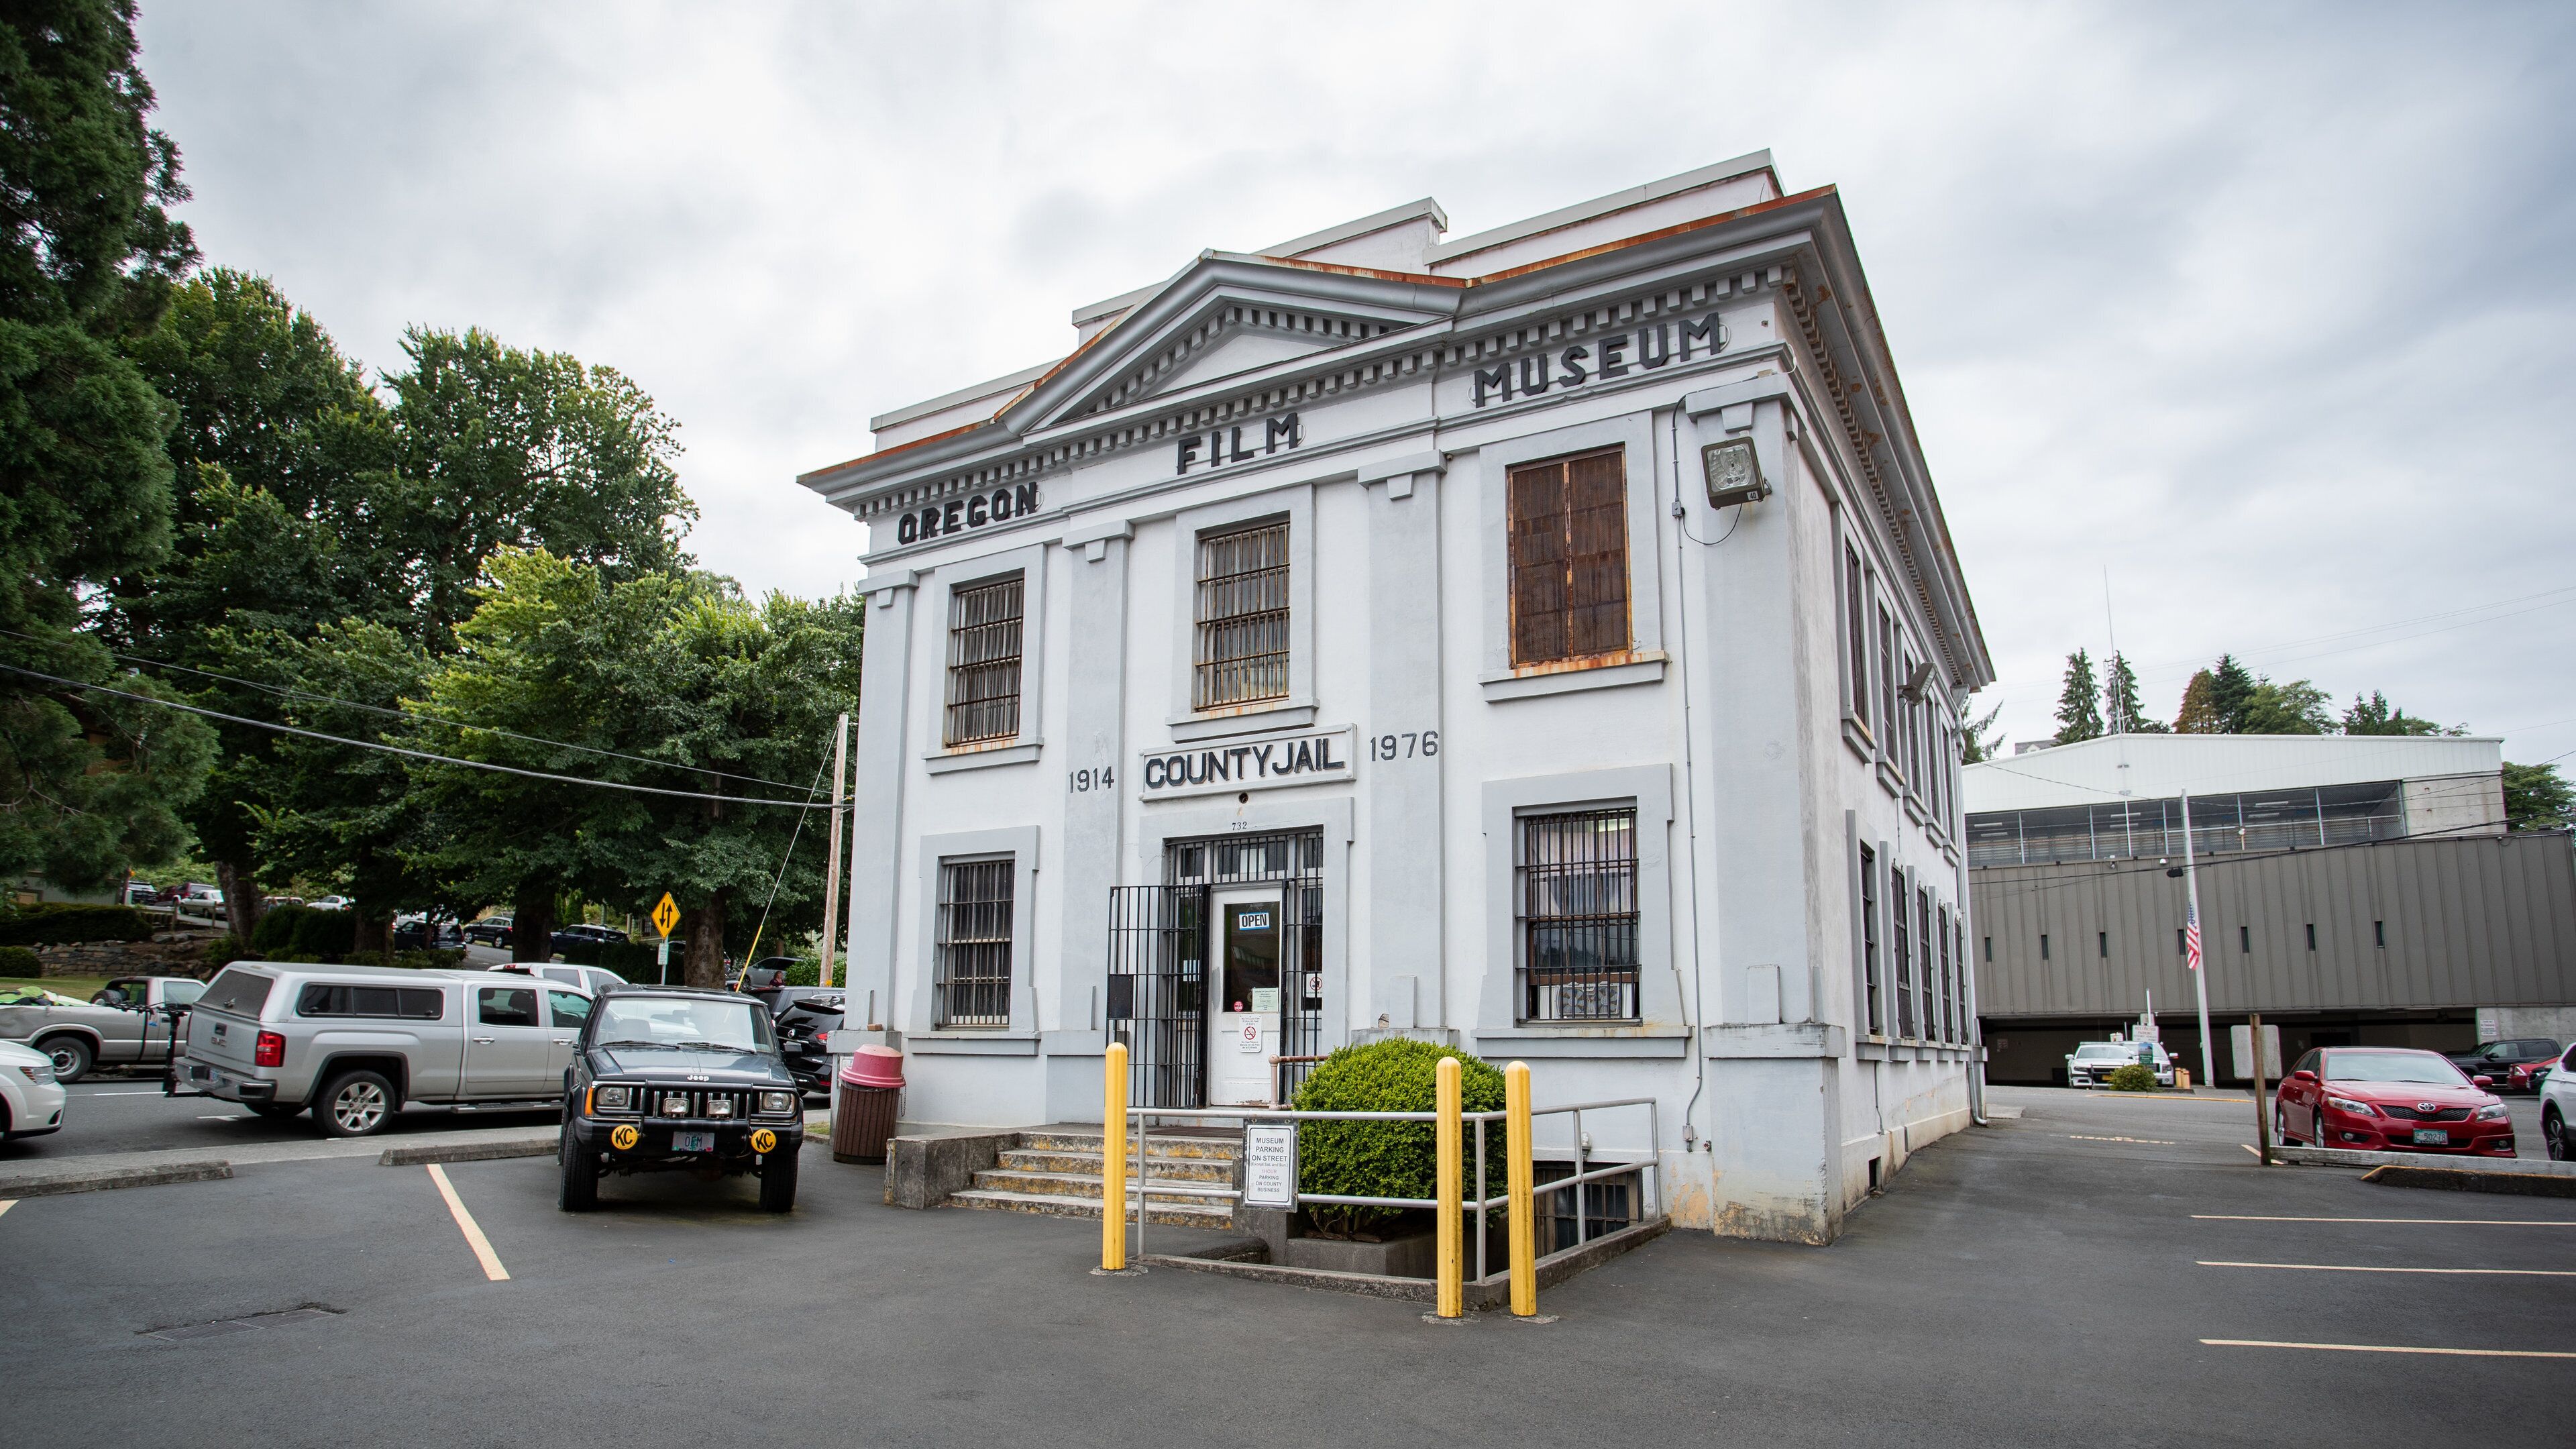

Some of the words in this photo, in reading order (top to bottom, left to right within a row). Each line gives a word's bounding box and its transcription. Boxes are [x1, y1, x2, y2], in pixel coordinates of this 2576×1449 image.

[1474, 311, 1720, 408] MUSEUM
[1177, 412, 1297, 476] FILM
[898, 481, 1037, 545] OREGON
[1371, 730, 1439, 762] 1976
[1069, 765, 1115, 793] 1914
[1232, 821, 1247, 830] 732
[1241, 914, 1267, 927] OPEN
[615, 1127, 633, 1146] KC
[755, 1132, 773, 1150] KC
[2424, 1132, 2446, 1141] 50278
